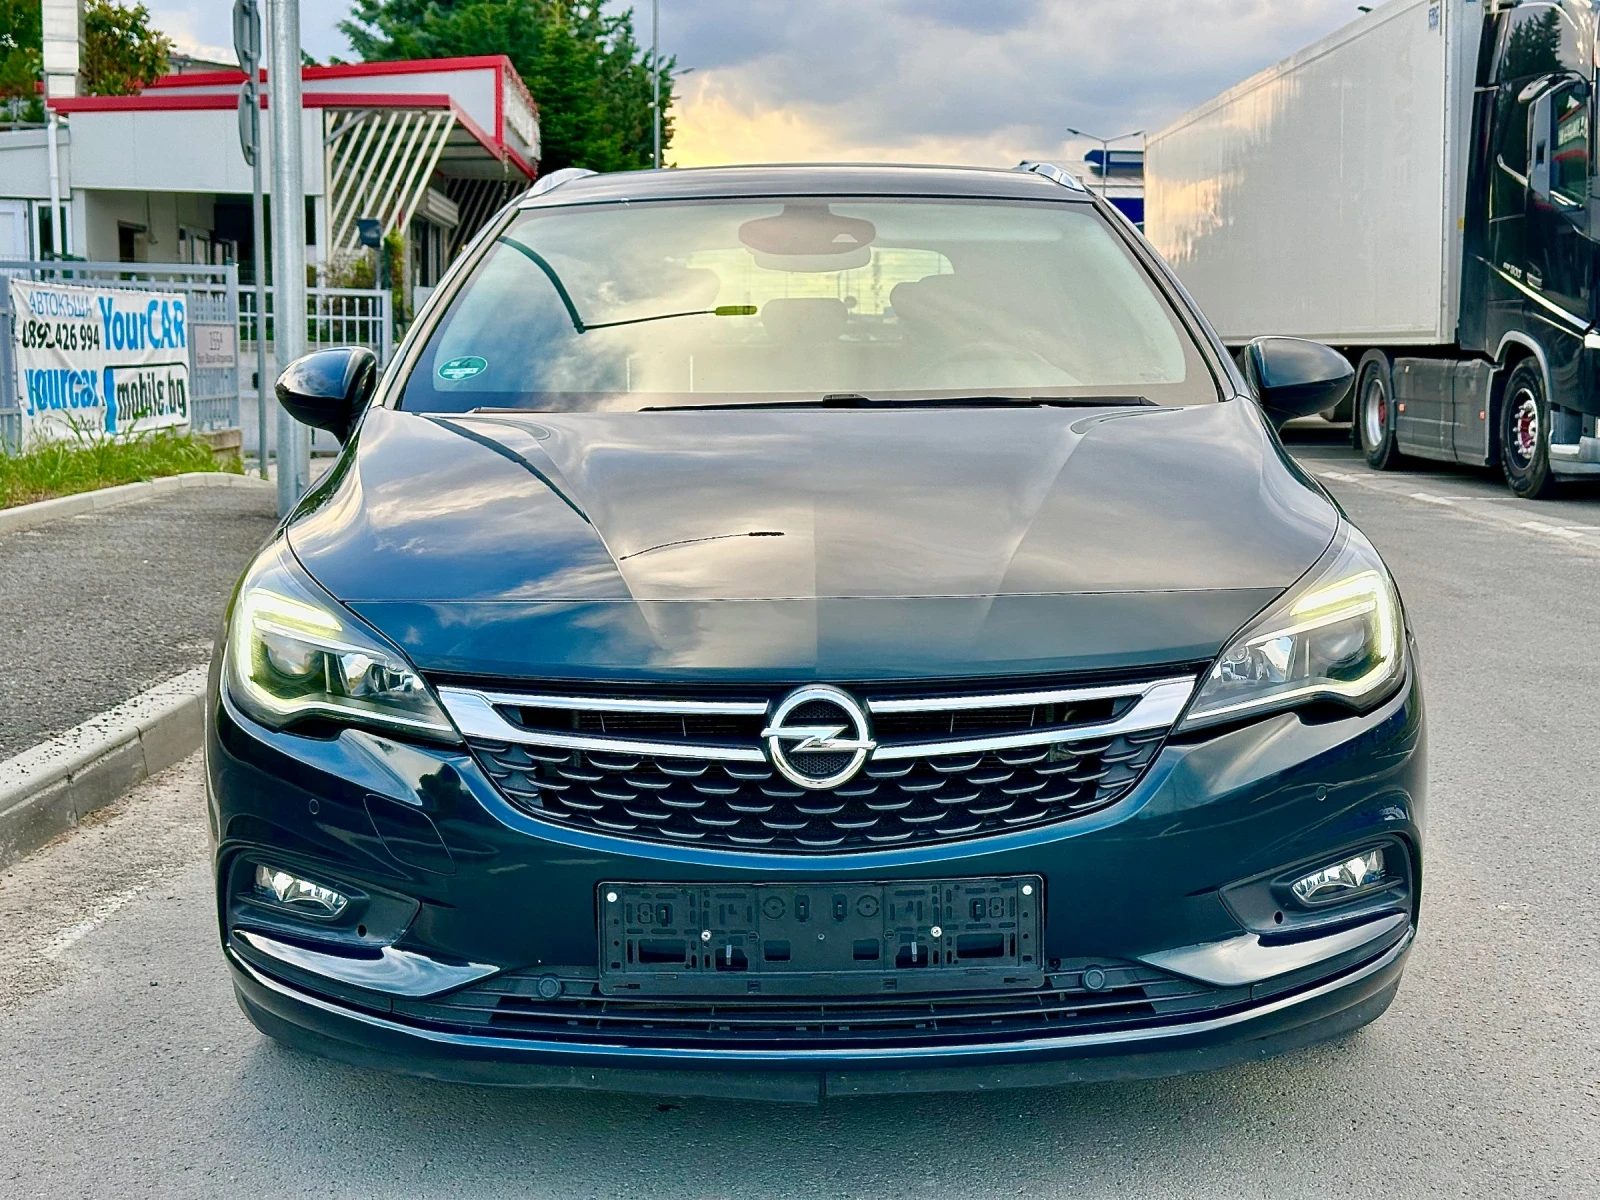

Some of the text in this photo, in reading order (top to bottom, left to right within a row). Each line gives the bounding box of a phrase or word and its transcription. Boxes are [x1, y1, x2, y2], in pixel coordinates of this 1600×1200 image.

[56, 323, 78, 350] 426
[80, 324, 100, 350] 994
[98, 296, 185, 350] YourCAR
[117, 370, 186, 420] mobile.bg
